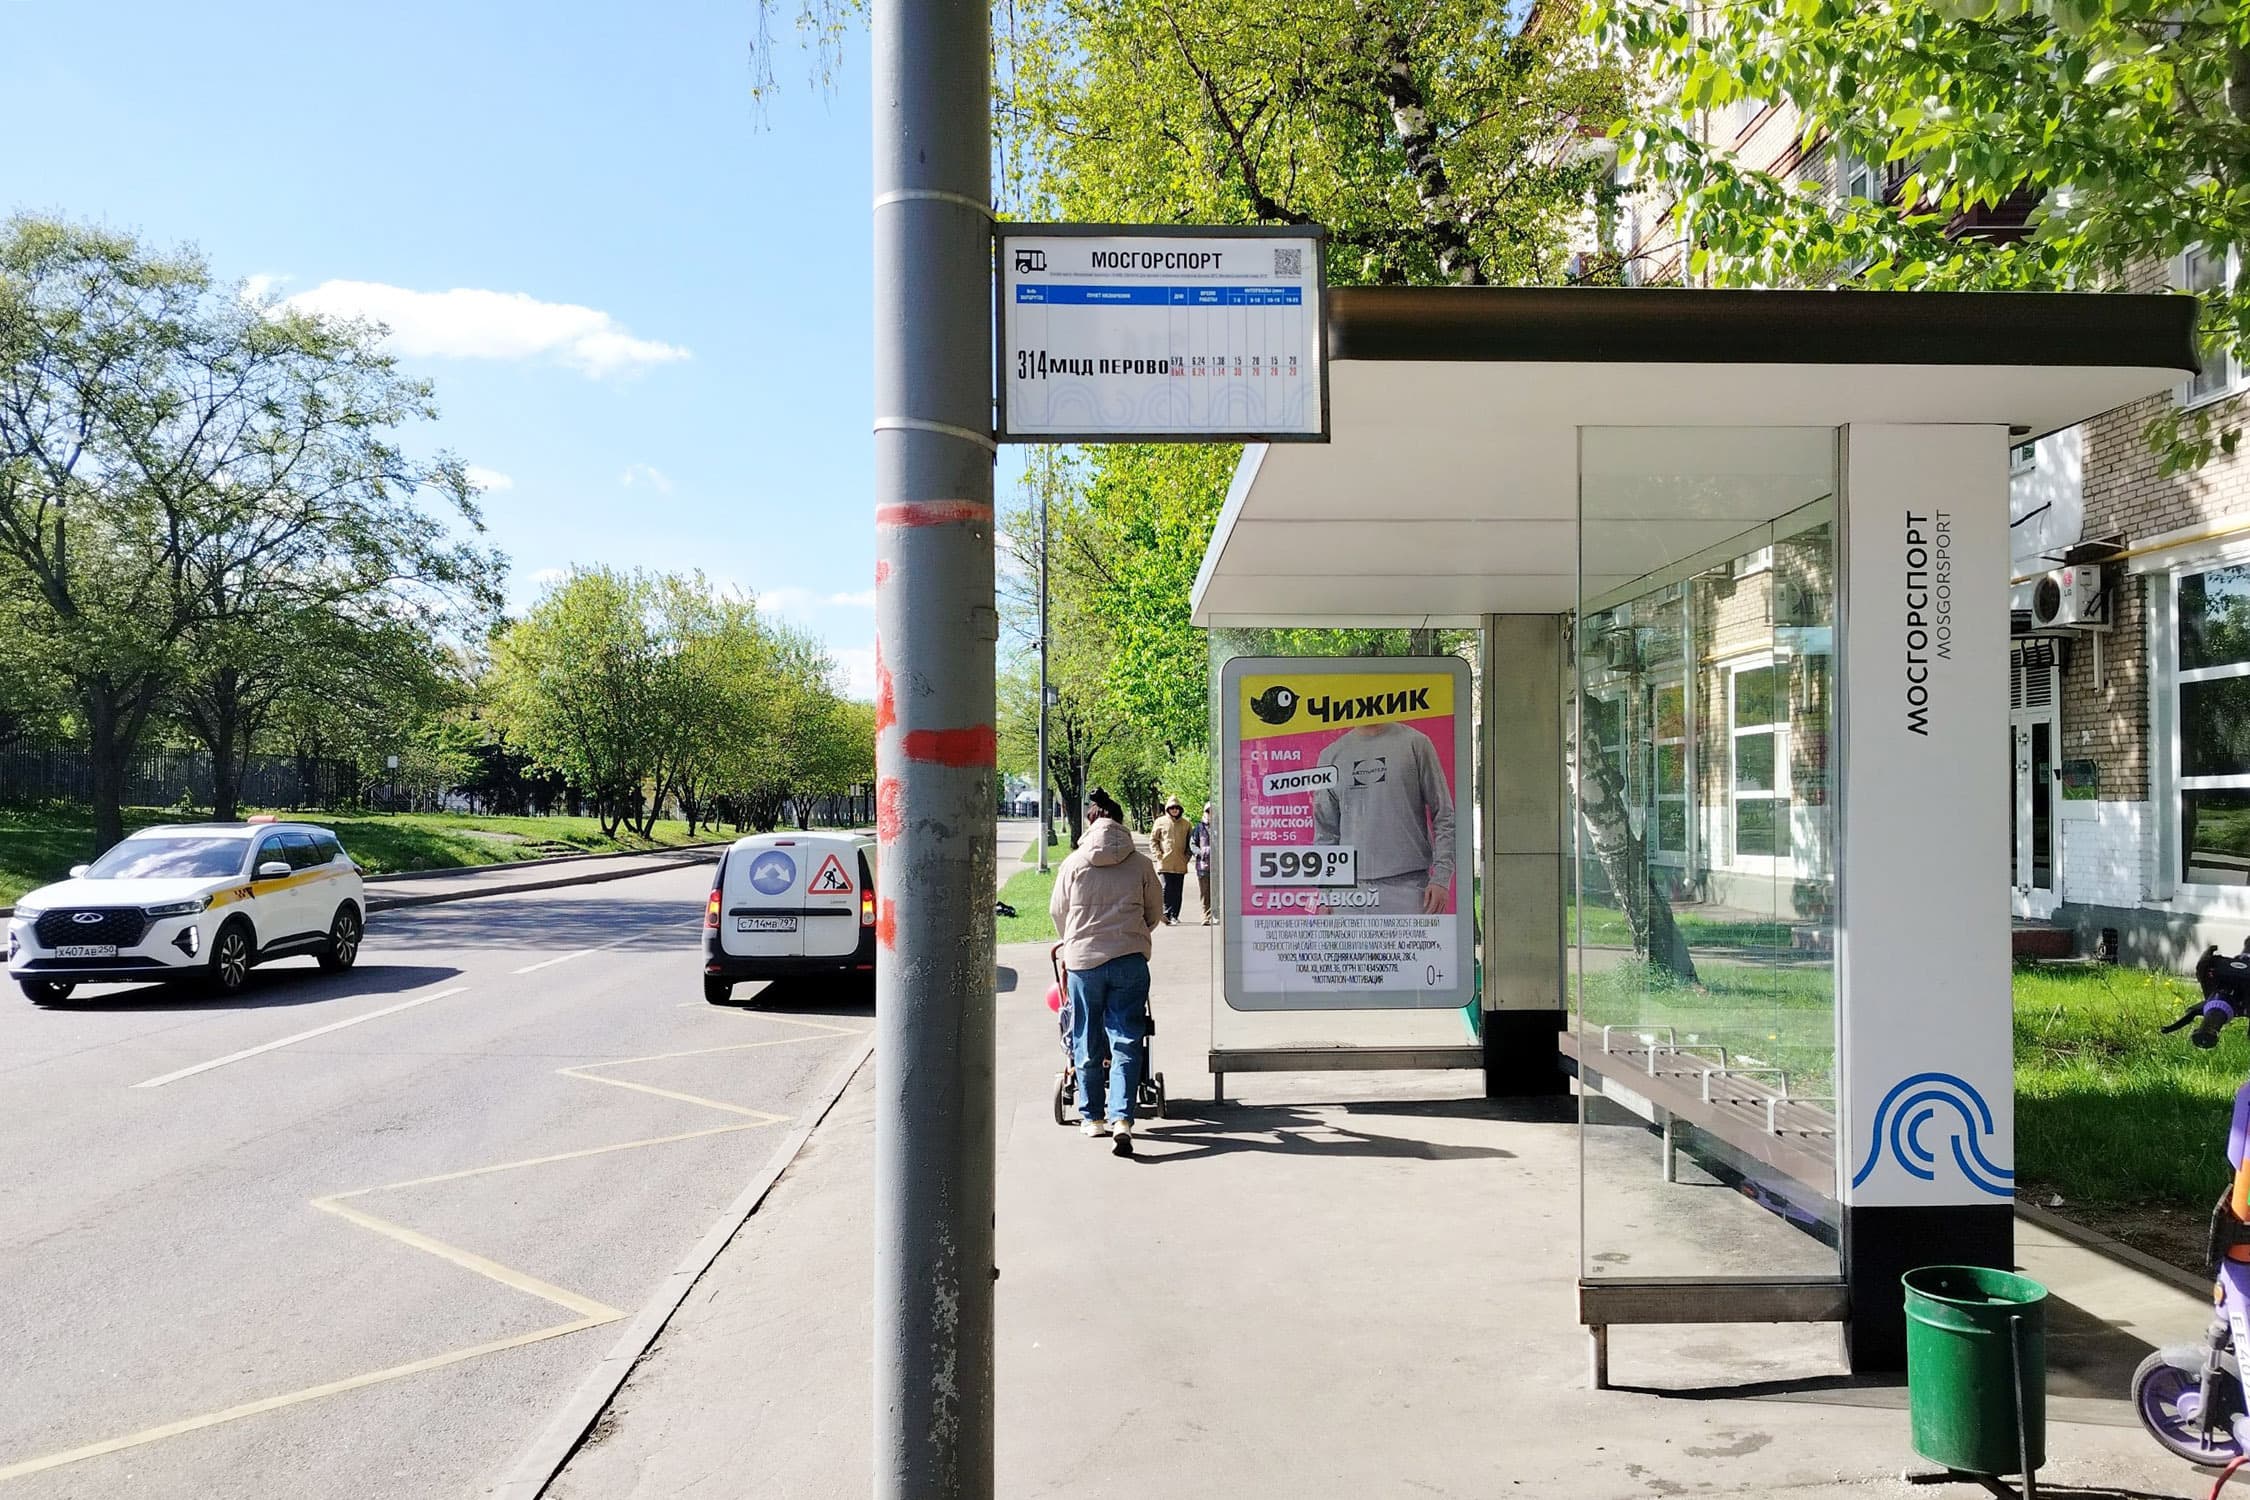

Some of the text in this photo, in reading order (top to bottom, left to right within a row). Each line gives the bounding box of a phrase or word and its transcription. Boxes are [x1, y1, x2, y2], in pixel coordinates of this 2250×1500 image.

[1092, 251, 1223, 269] МОСГОРСПОРТ
[1018, 350, 1169, 380] 314 МЦД ПЕРОВО
[1234, 356, 1242, 366] 15
[1270, 356, 1278, 366] 15
[1936, 509, 1952, 660] MOSGORSPORT
[1907, 510, 1929, 736] МОСГОРСПОРТ
[1251, 750, 1301, 761] С 1 МАЯ
[1270, 772, 1332, 791] ХЛОПОК
[1250, 805, 1309, 815] СВИТШОТ
[1250, 816, 1313, 828] МУЖСКОЙ
[1262, 832, 1297, 841] 48-56
[1259, 852, 1349, 878] 599 00
[1251, 888, 1380, 909] С ДОСТАВКОЙ
[1426, 964, 1444, 986] 0+
